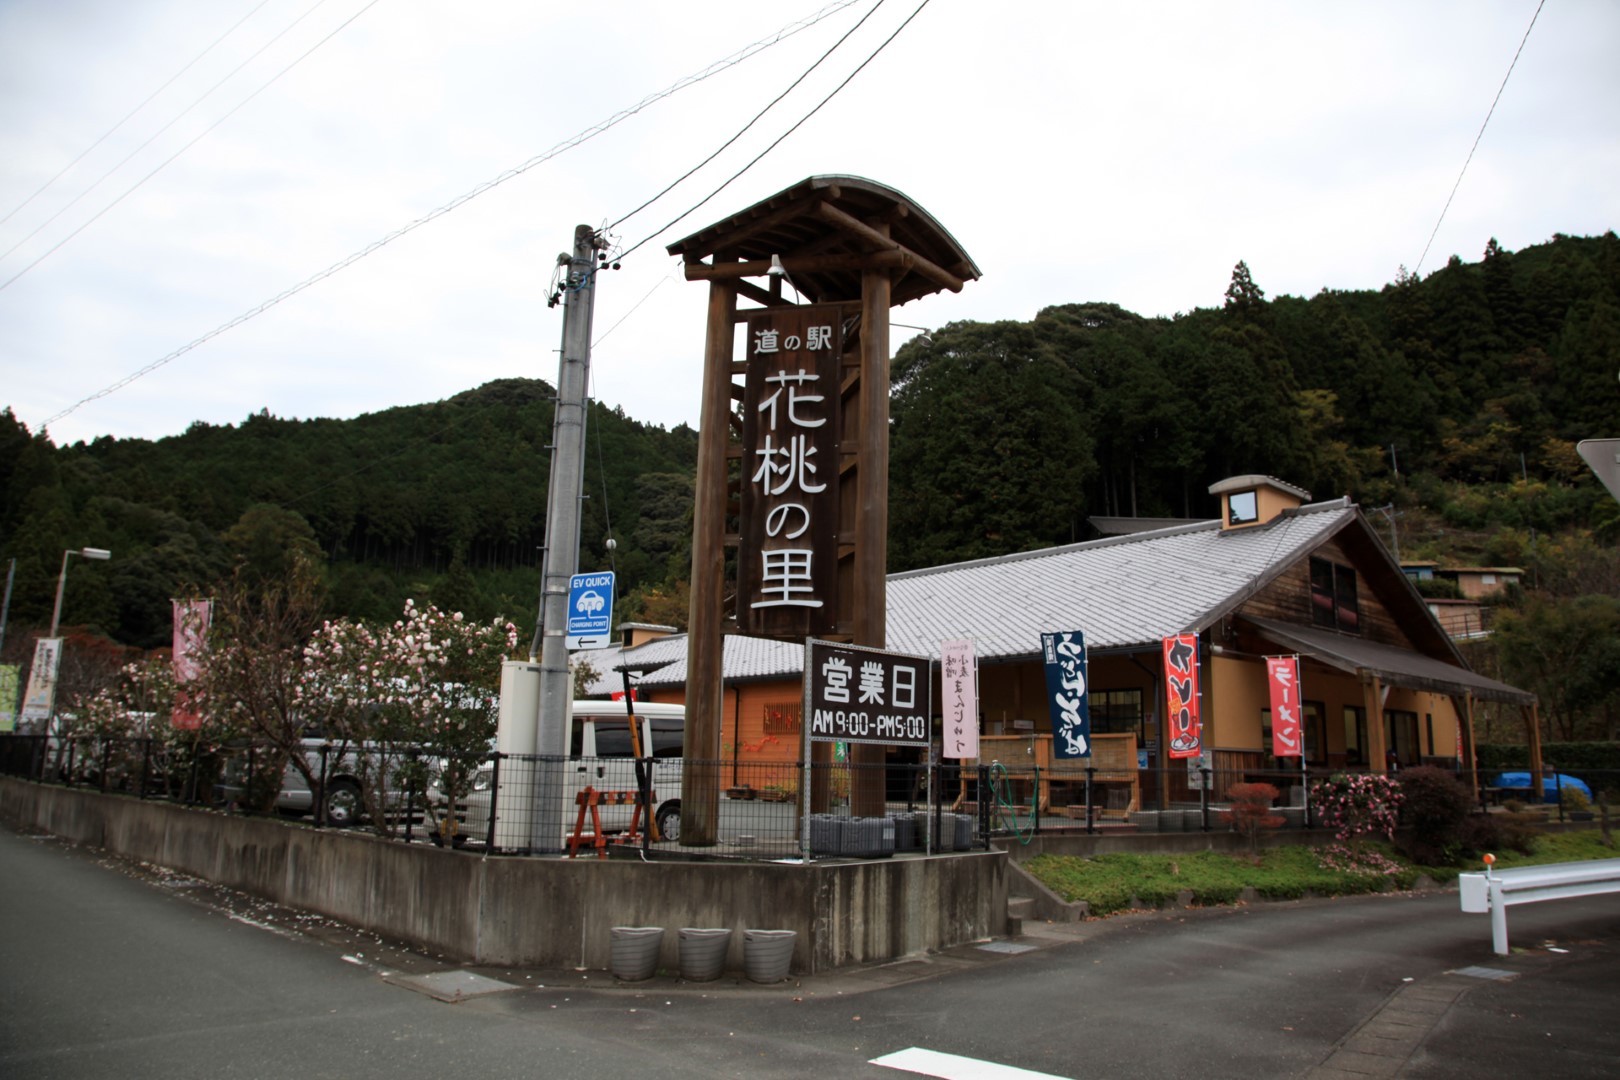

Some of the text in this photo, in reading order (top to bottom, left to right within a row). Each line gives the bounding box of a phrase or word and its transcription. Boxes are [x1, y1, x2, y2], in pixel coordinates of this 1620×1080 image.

[753, 325, 832, 354] 道の駅
[750, 368, 827, 609] 花桃の里
[573, 576, 611, 589] EV QUICK
[822, 656, 916, 709] 営業日
